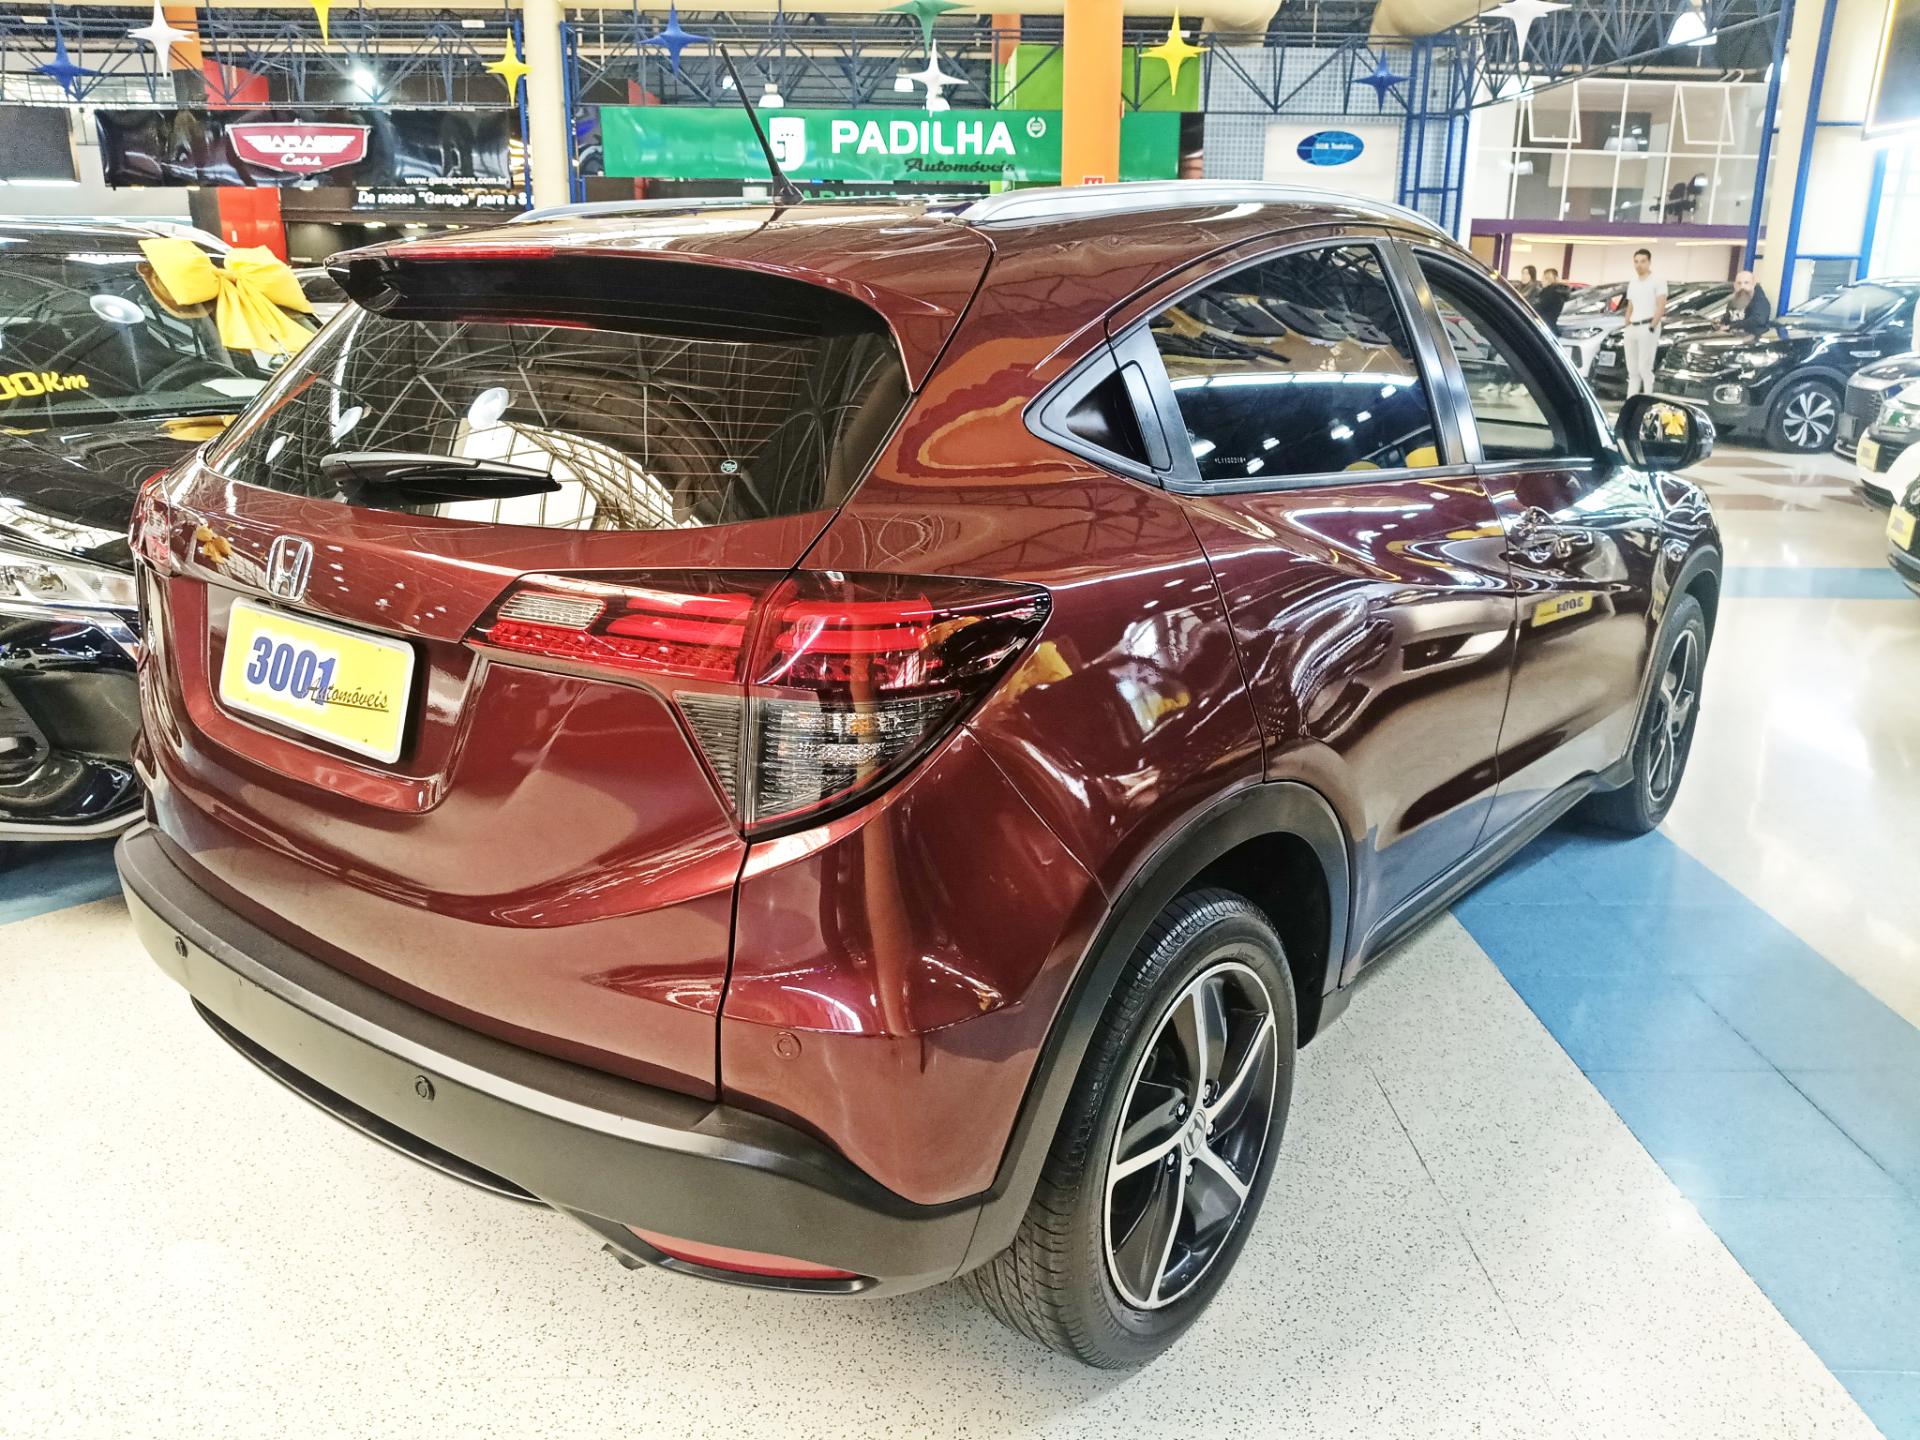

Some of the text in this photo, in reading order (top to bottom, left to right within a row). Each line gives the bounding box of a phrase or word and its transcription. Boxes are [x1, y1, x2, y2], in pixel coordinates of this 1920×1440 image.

[831, 120, 1016, 155] PADILHA
[904, 157, 1015, 173] Automóveis
[358, 191, 376, 204] Da
[476, 194, 505, 207] para
[507, 194, 516, 204] a
[247, 636, 336, 706] 3001
[303, 677, 389, 712] Automóveis
